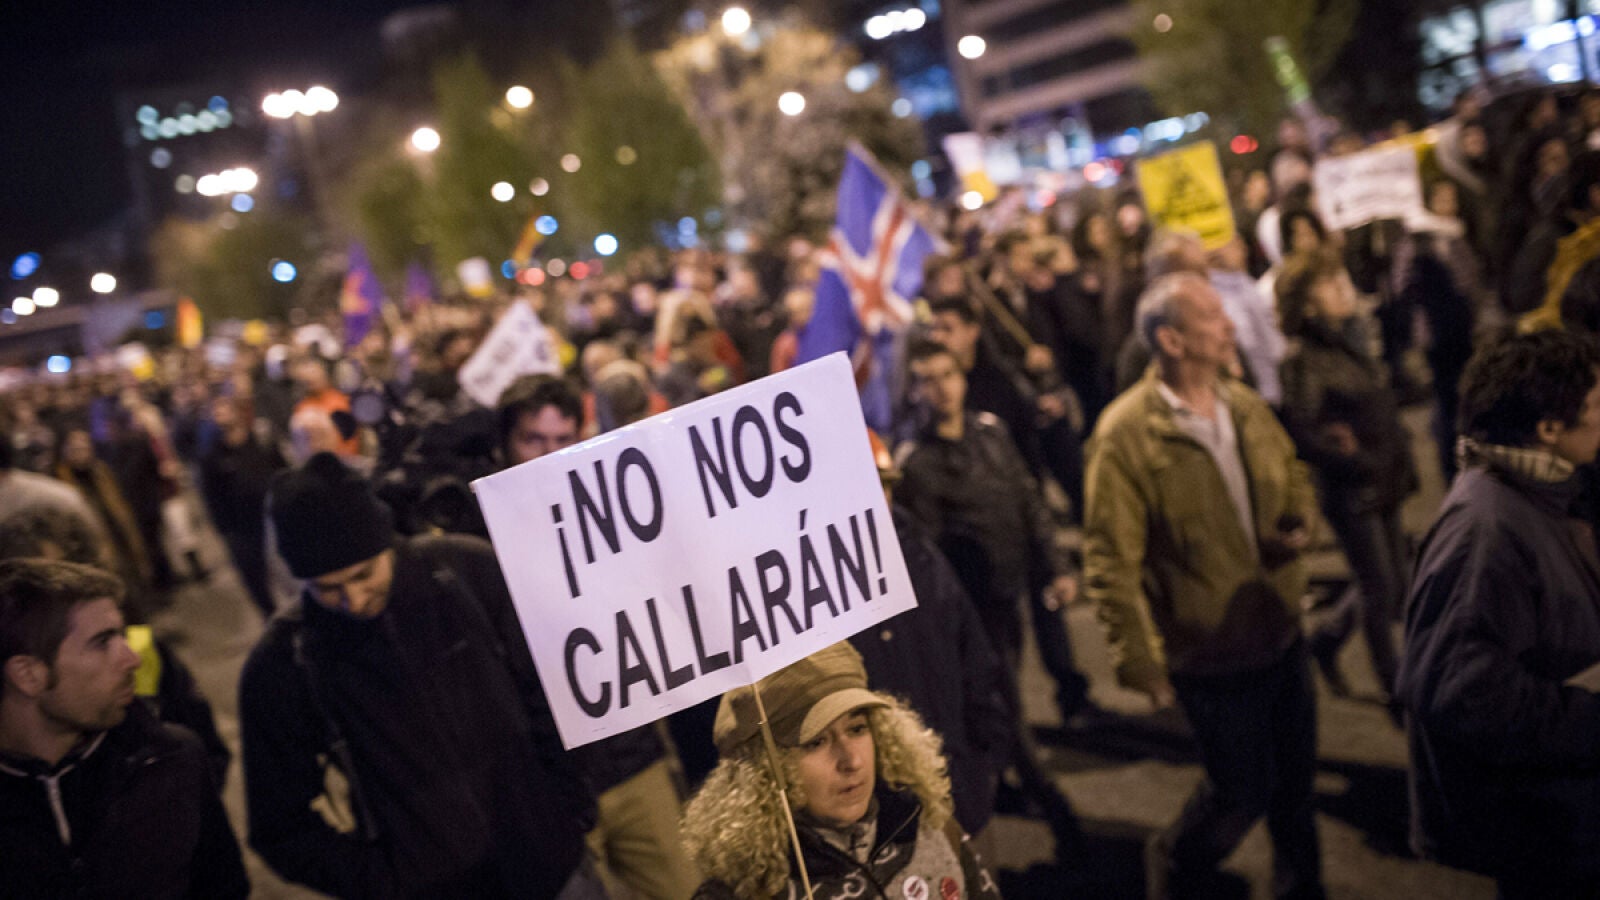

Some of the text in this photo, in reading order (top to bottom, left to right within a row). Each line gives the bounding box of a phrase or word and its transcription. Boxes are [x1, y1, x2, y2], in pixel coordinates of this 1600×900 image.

[551, 391, 812, 599] ¡NO NOS
[564, 508, 888, 719] CALLARÁN!
